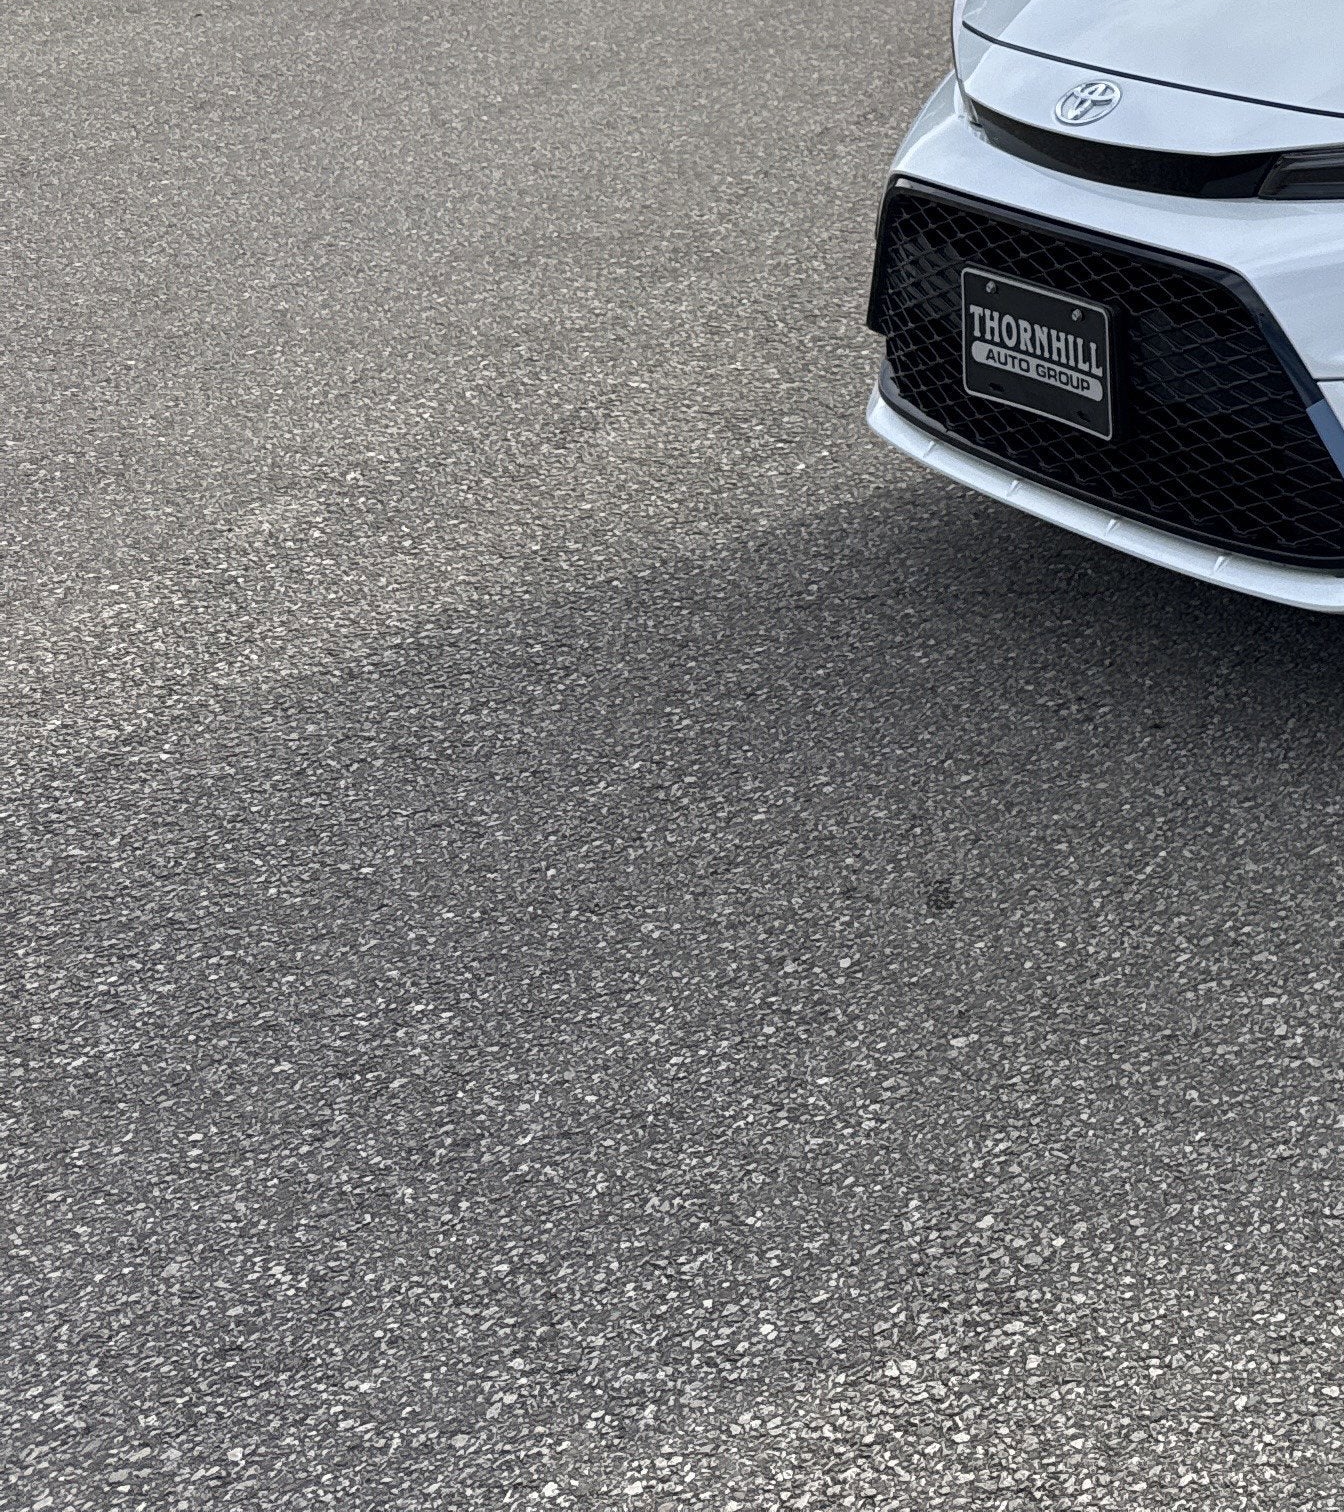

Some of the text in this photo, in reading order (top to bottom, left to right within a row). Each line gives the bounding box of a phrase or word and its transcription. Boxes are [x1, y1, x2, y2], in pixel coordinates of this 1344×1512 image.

[969, 304, 1104, 377] THORNHILL
[985, 348, 1091, 392] AUTO GROUP
